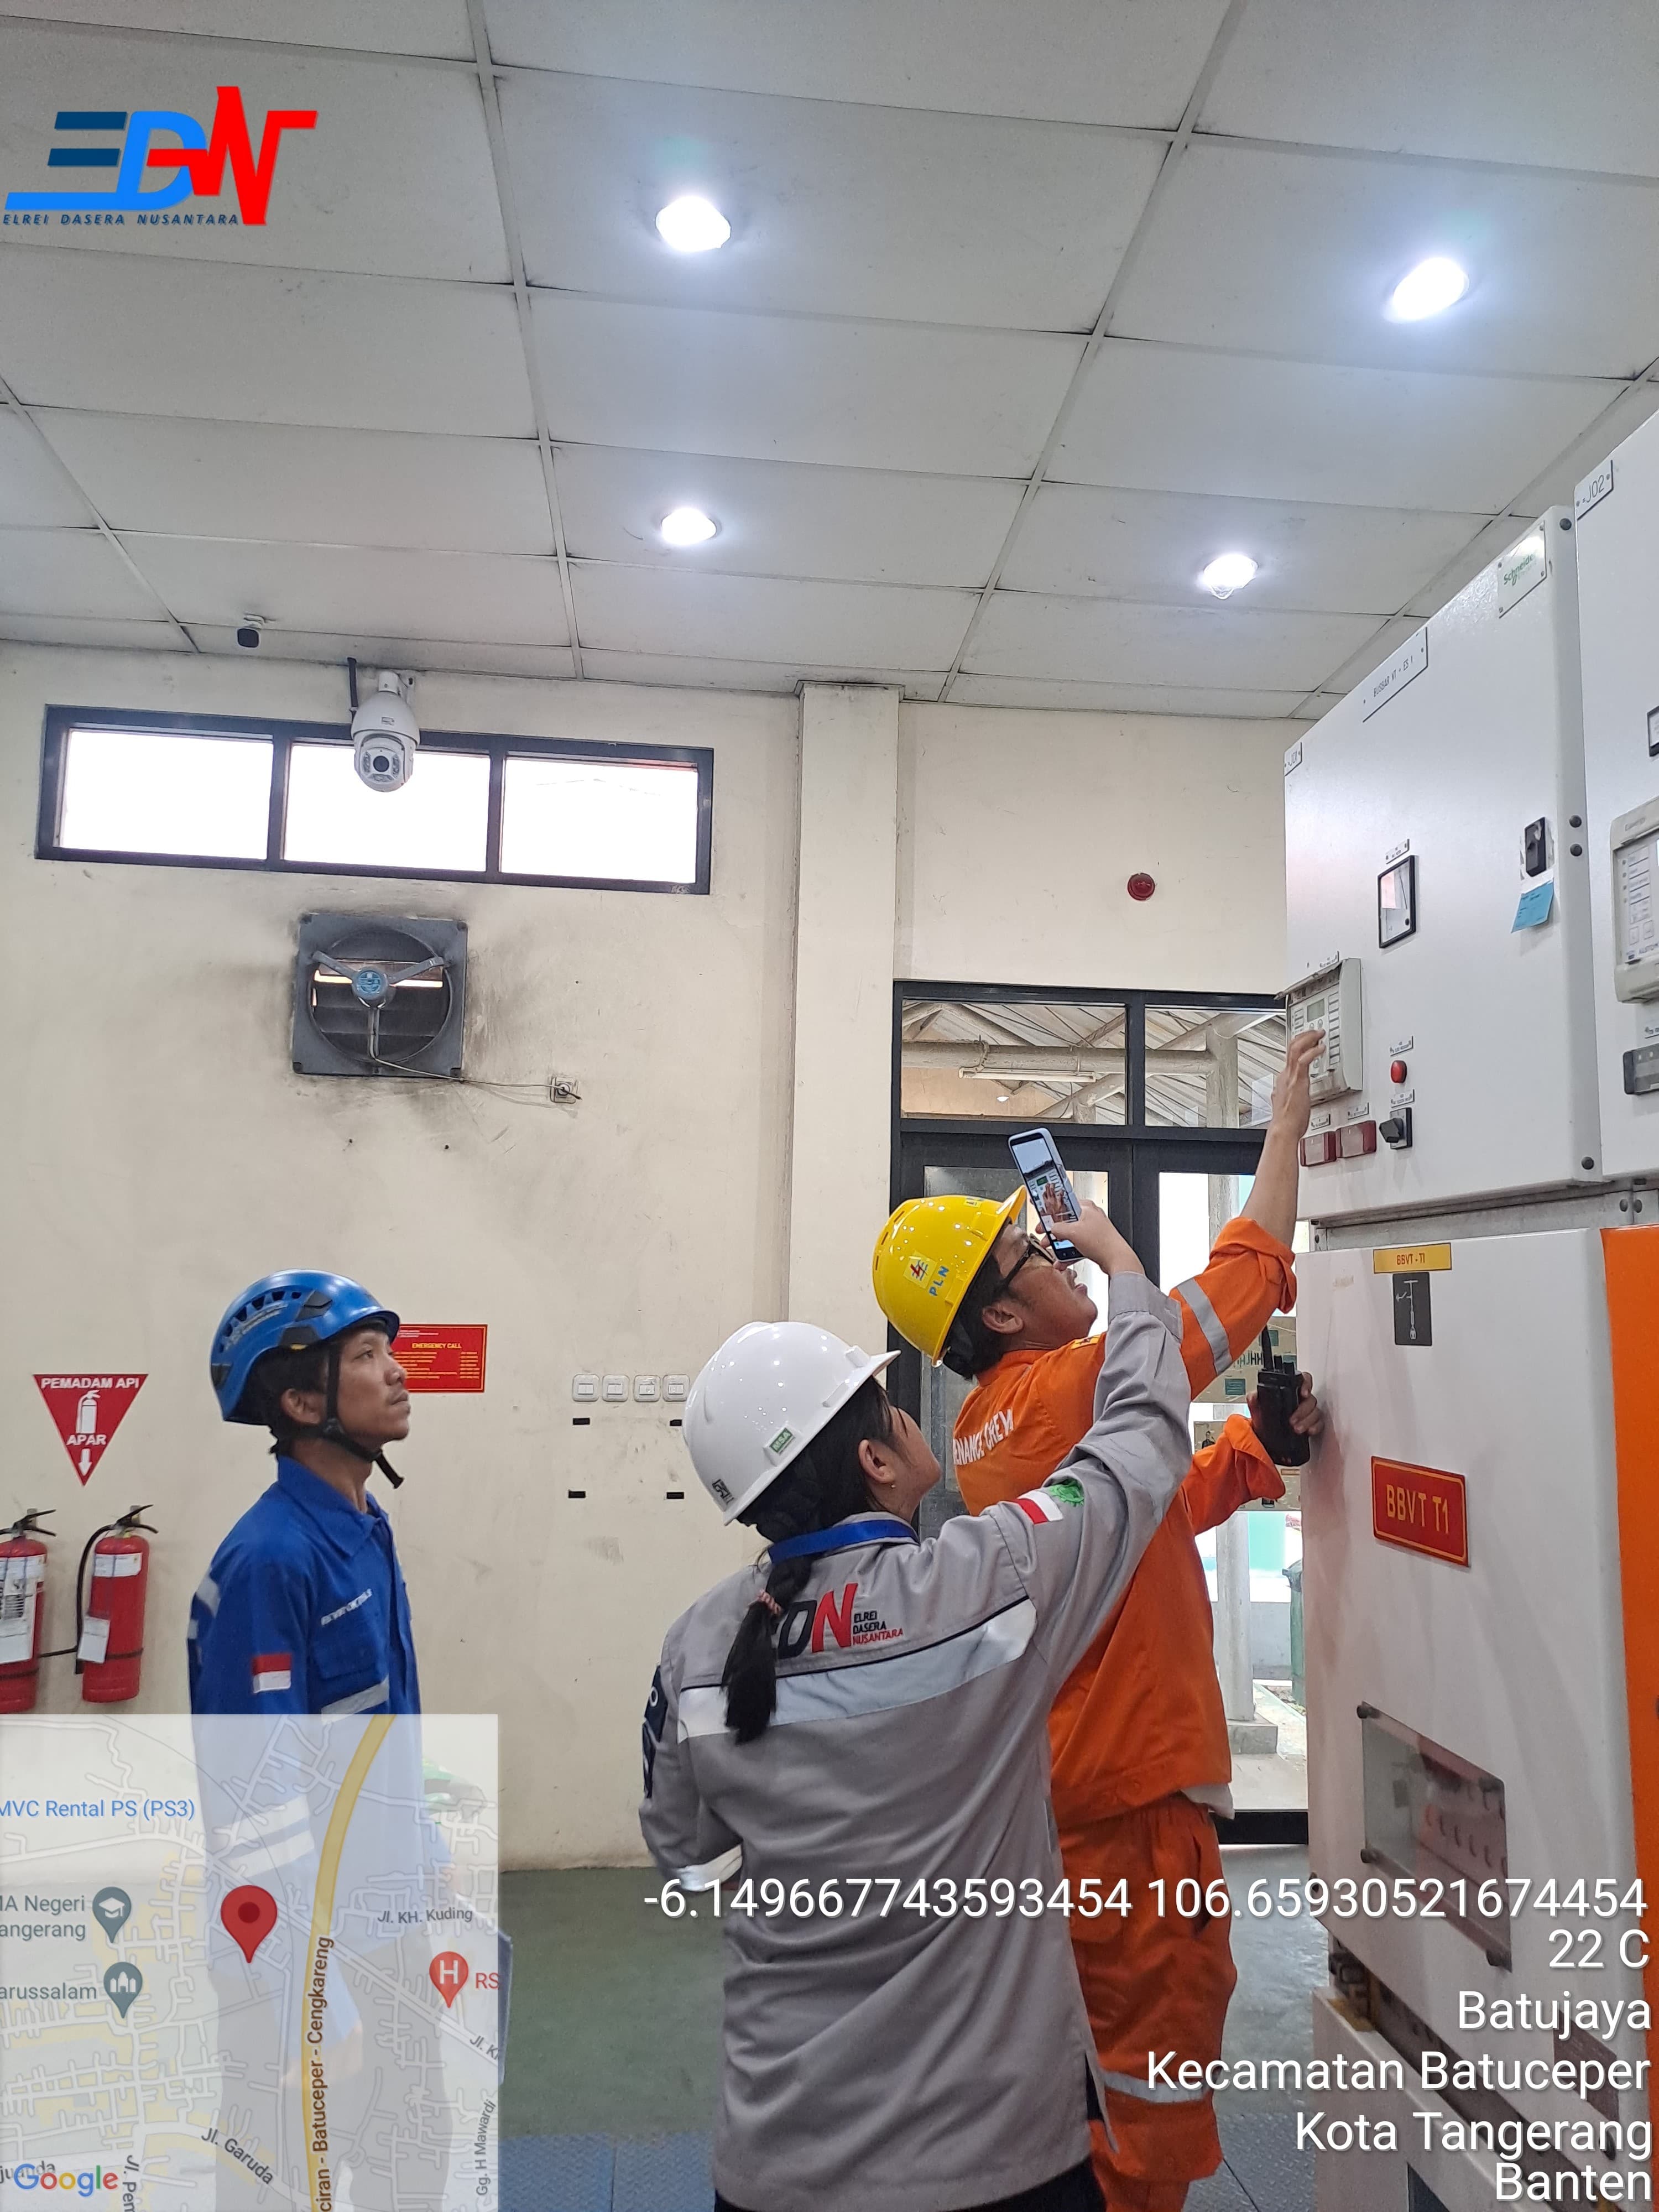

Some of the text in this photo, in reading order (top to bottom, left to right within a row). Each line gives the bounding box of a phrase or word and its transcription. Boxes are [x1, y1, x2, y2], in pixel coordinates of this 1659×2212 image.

[1504, 552, 1536, 586] Schneide
[1396, 1254, 1413, 1265] BBVT
[928, 1265, 950, 1296] PLN
[41, 1378, 140, 1389] PEMADAM API
[984, 1408, 1014, 1451] CREW
[66, 1434, 107, 1446] APAR
[1386, 1484, 1448, 1534] BBVT T1
[775, 1582, 858, 1659] DN
[854, 1610, 878, 1624] ELREI
[853, 1620, 887, 1635] DASERA
[852, 1628, 903, 1645] NUSANTARA
